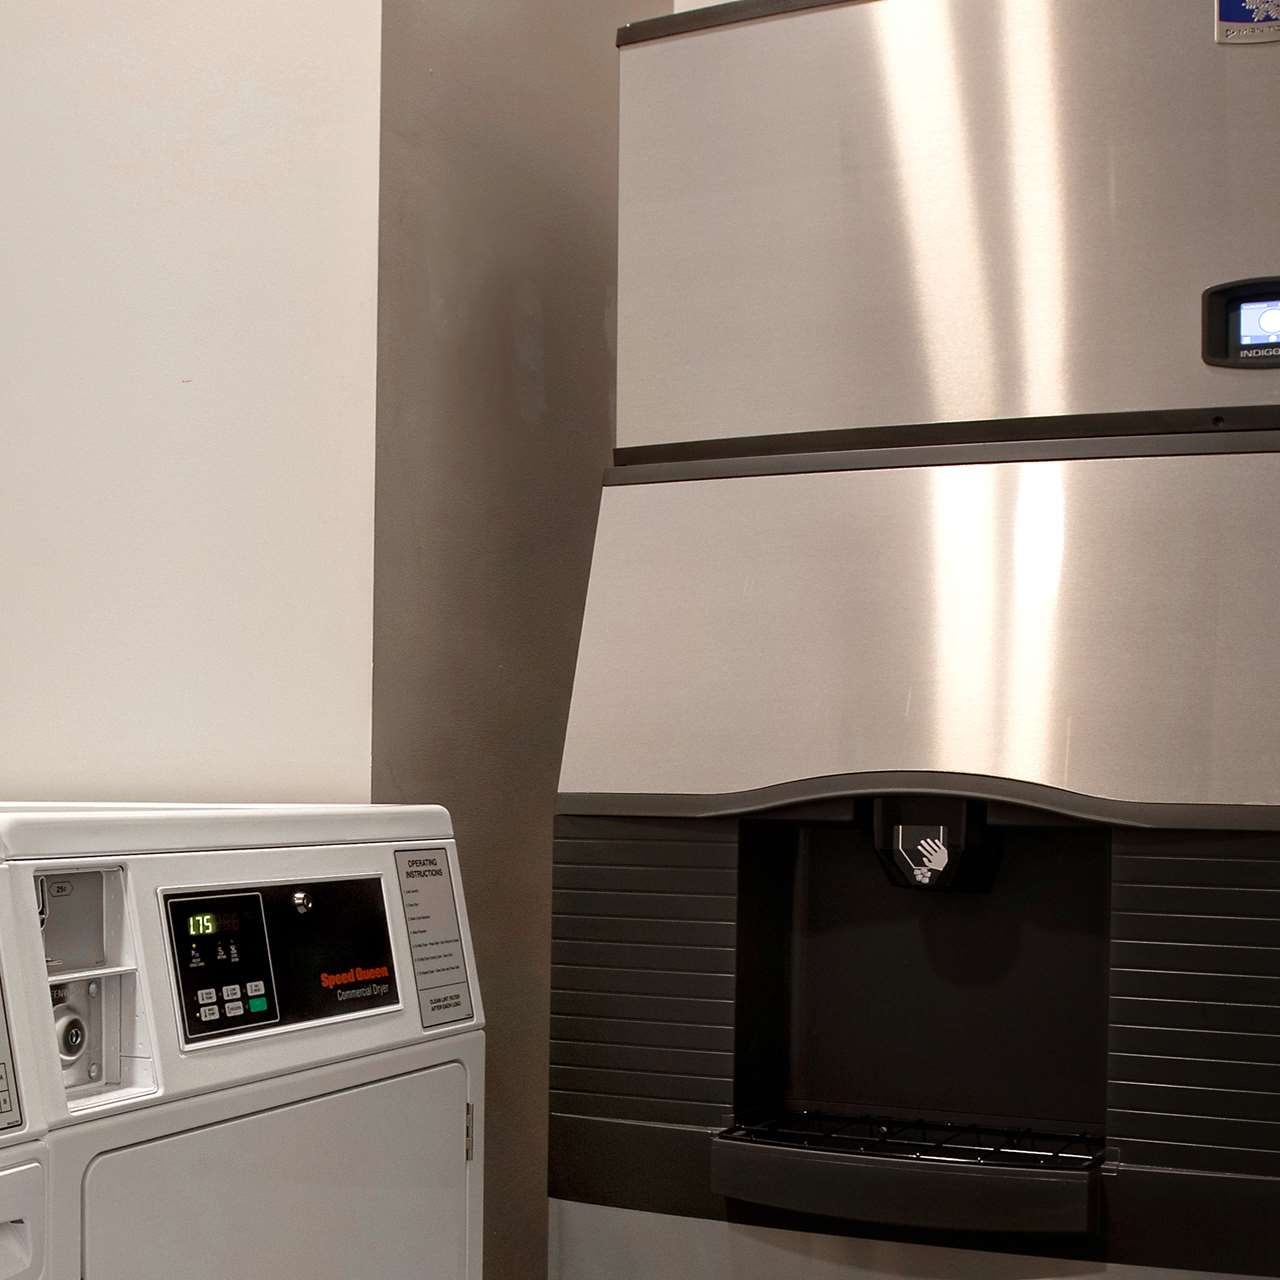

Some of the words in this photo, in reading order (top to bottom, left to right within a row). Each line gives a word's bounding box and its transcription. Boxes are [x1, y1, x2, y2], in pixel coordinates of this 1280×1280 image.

[407, 859, 437, 868] OPERATING
[406, 869, 443, 879] INSTRUCTIONS
[320, 969, 355, 989] Speed
[355, 966, 390, 981] Queen
[337, 984, 372, 1001] Commercial
[372, 984, 389, 997] Dryer
